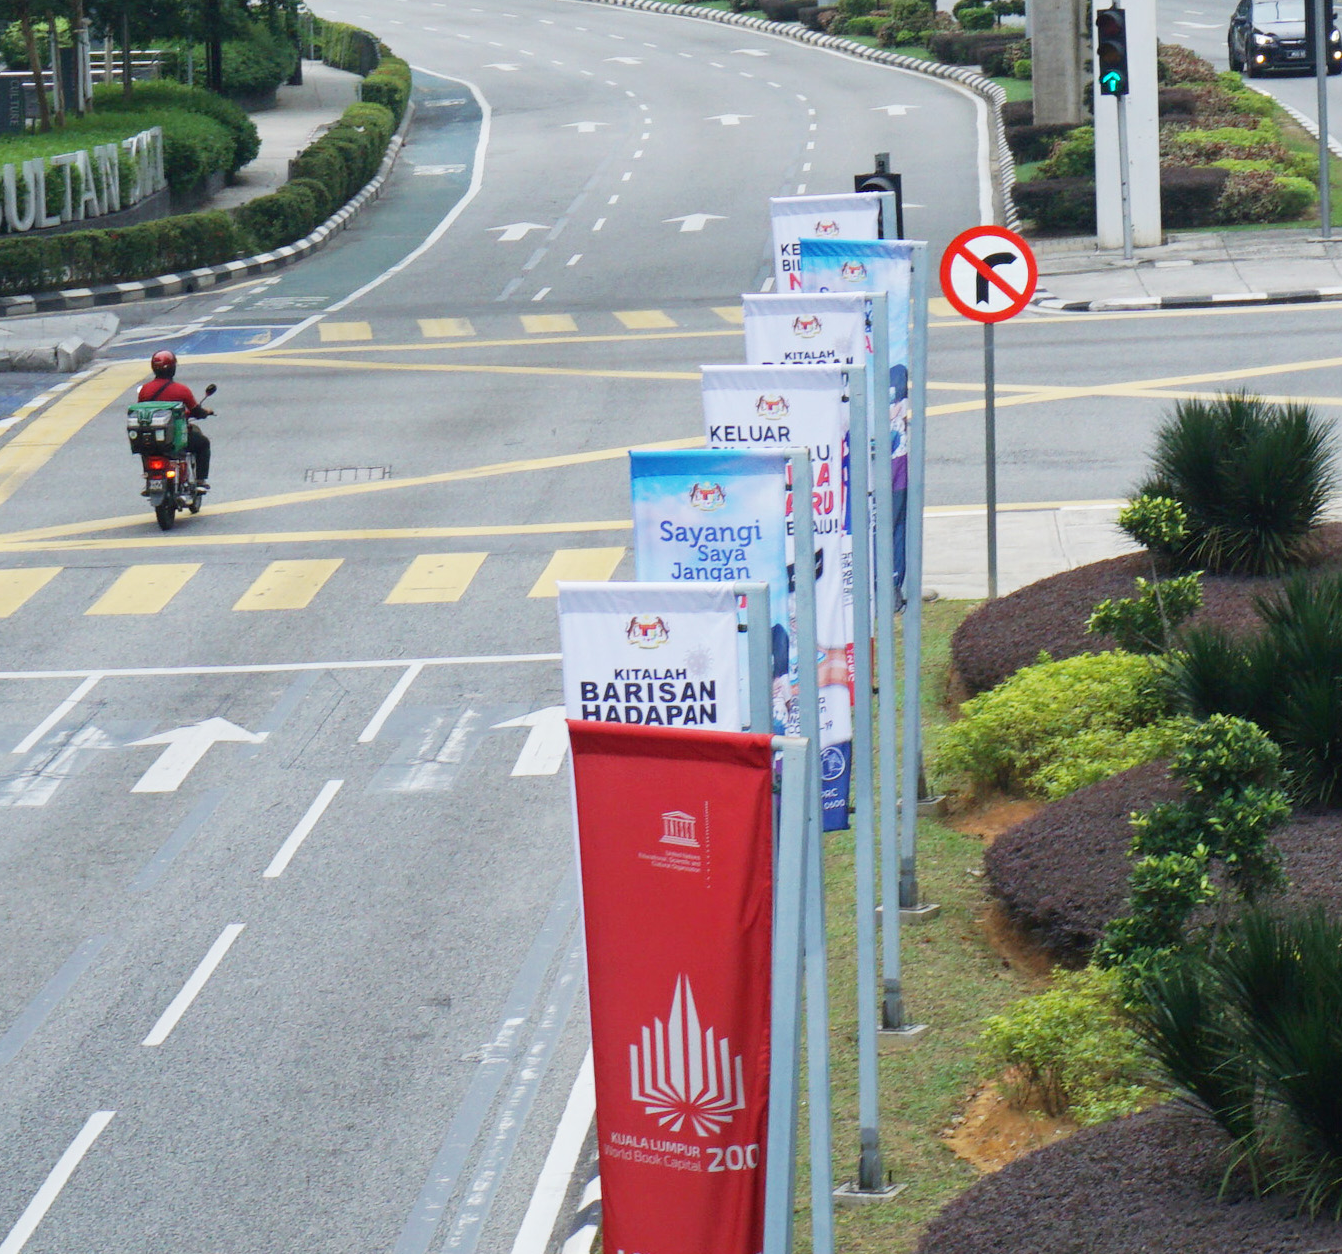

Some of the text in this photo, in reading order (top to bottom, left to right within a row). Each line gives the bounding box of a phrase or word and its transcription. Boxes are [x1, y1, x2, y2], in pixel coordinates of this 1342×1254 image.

[784, 349, 835, 361] KITALAH
[709, 425, 791, 443] KELUAR
[659, 519, 762, 548] Sayangi
[697, 545, 747, 567] Saya
[671, 562, 751, 582] Jangan
[614, 668, 687, 681] KITALAH
[580, 680, 716, 704] BARISAN
[581, 703, 717, 726] HADAPAN
[611, 1132, 701, 1158] KUALA LUMPUR
[604, 1144, 703, 1173] World Book Capital
[705, 1143, 760, 1173] 200
